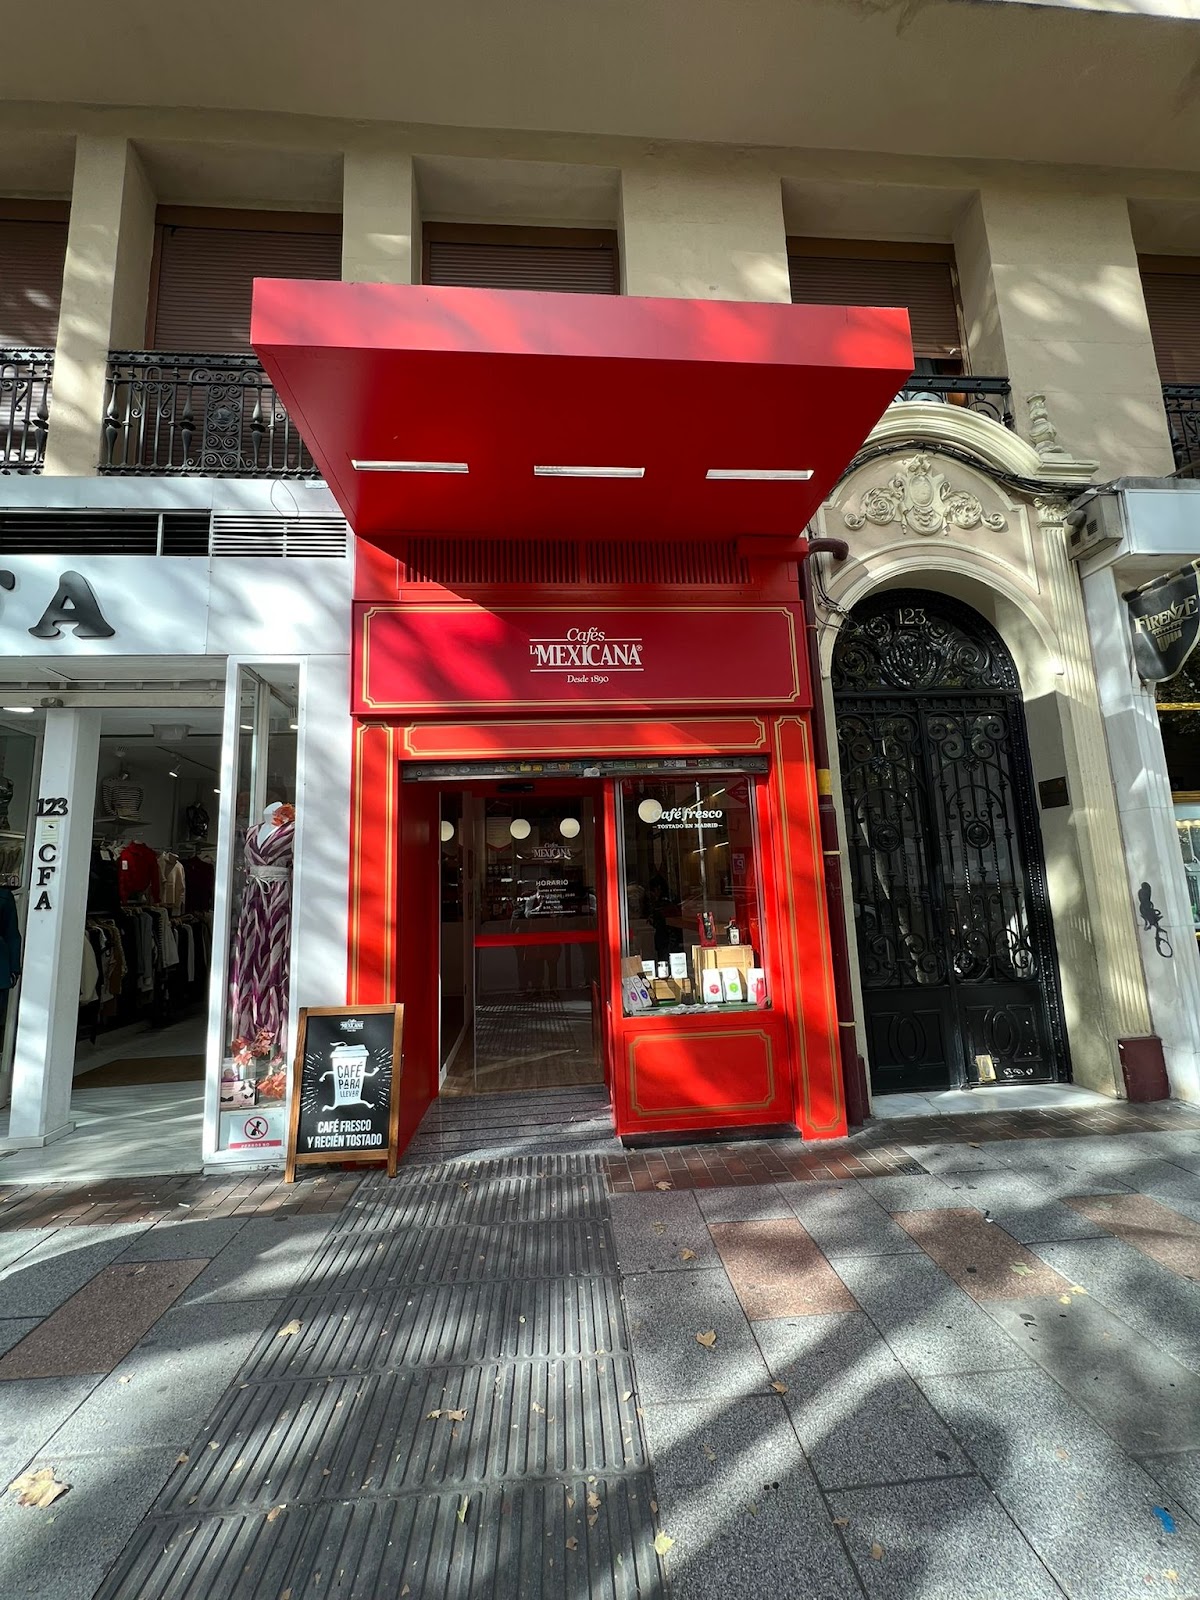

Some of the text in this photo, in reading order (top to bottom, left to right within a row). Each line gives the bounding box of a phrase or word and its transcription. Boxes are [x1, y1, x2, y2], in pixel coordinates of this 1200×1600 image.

[899, 608, 926, 625] 123
[1134, 595, 1198, 633] FIRENZE
[567, 627, 605, 644] Cafés
[567, 674, 609, 684] Desde 1890
[35, 797, 68, 816] 123
[681, 807, 723, 821] fresco
[536, 879, 569, 887] HORARIO
[337, 1061, 363, 1078] CAFÉ
[338, 1079, 360, 1089] PARA
[317, 1119, 372, 1133] CAFÉ FRESCO
[307, 1133, 382, 1148] Y RECIÉN TOSTADO
